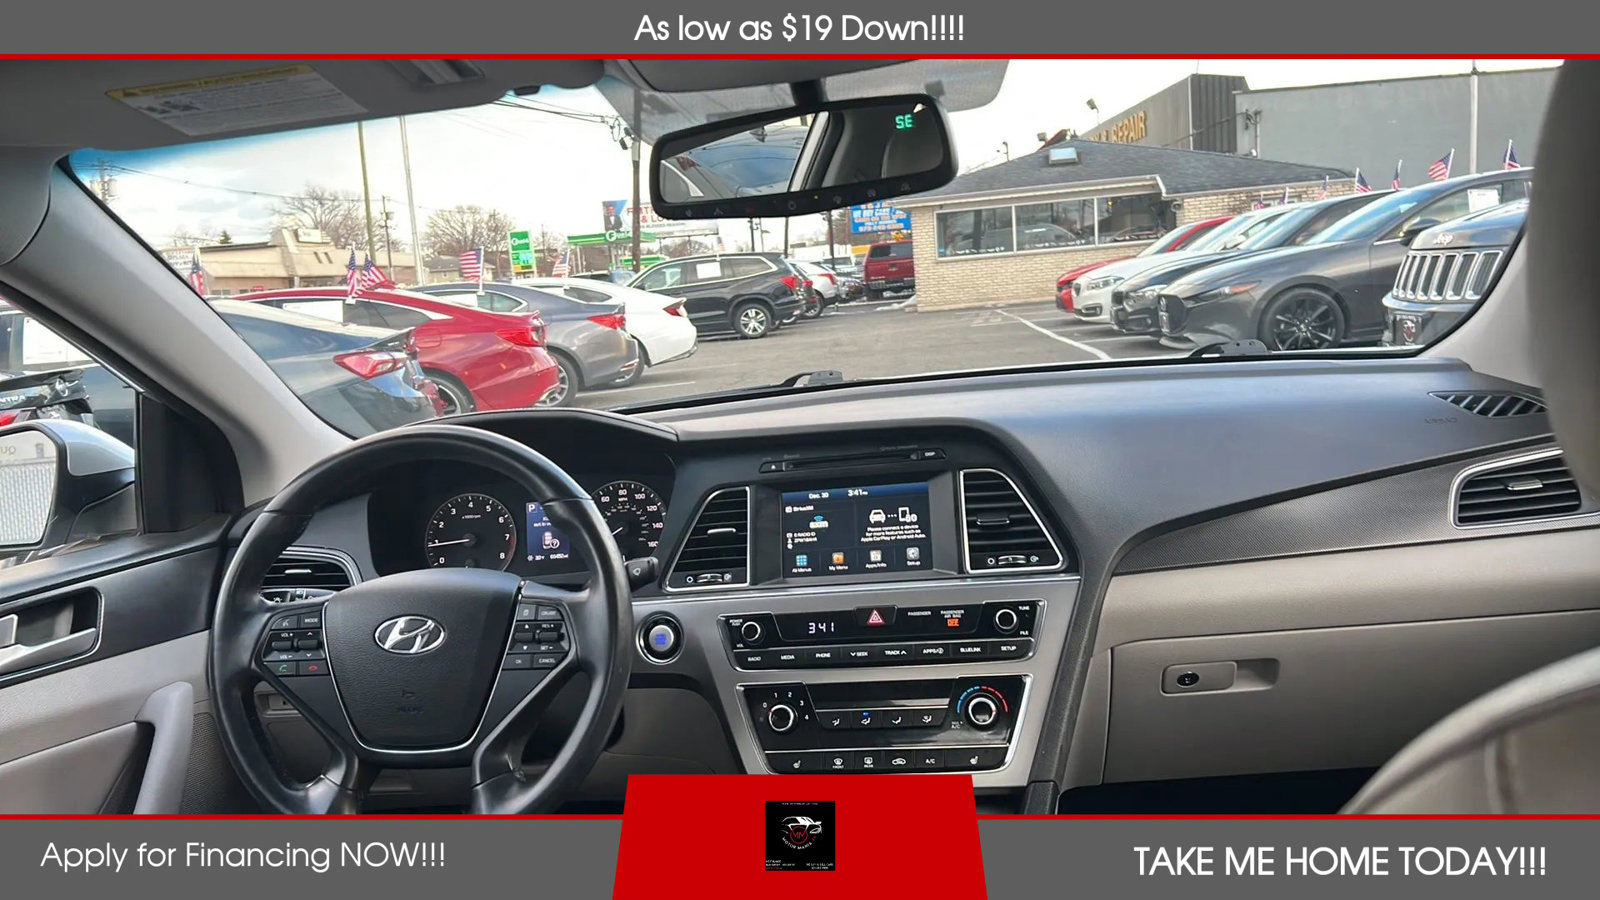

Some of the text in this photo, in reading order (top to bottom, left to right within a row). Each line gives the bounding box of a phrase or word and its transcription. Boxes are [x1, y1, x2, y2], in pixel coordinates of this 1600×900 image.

[895, 114, 912, 129] SE
[1112, 110, 1147, 143] REPAIR
[528, 504, 535, 512] P
